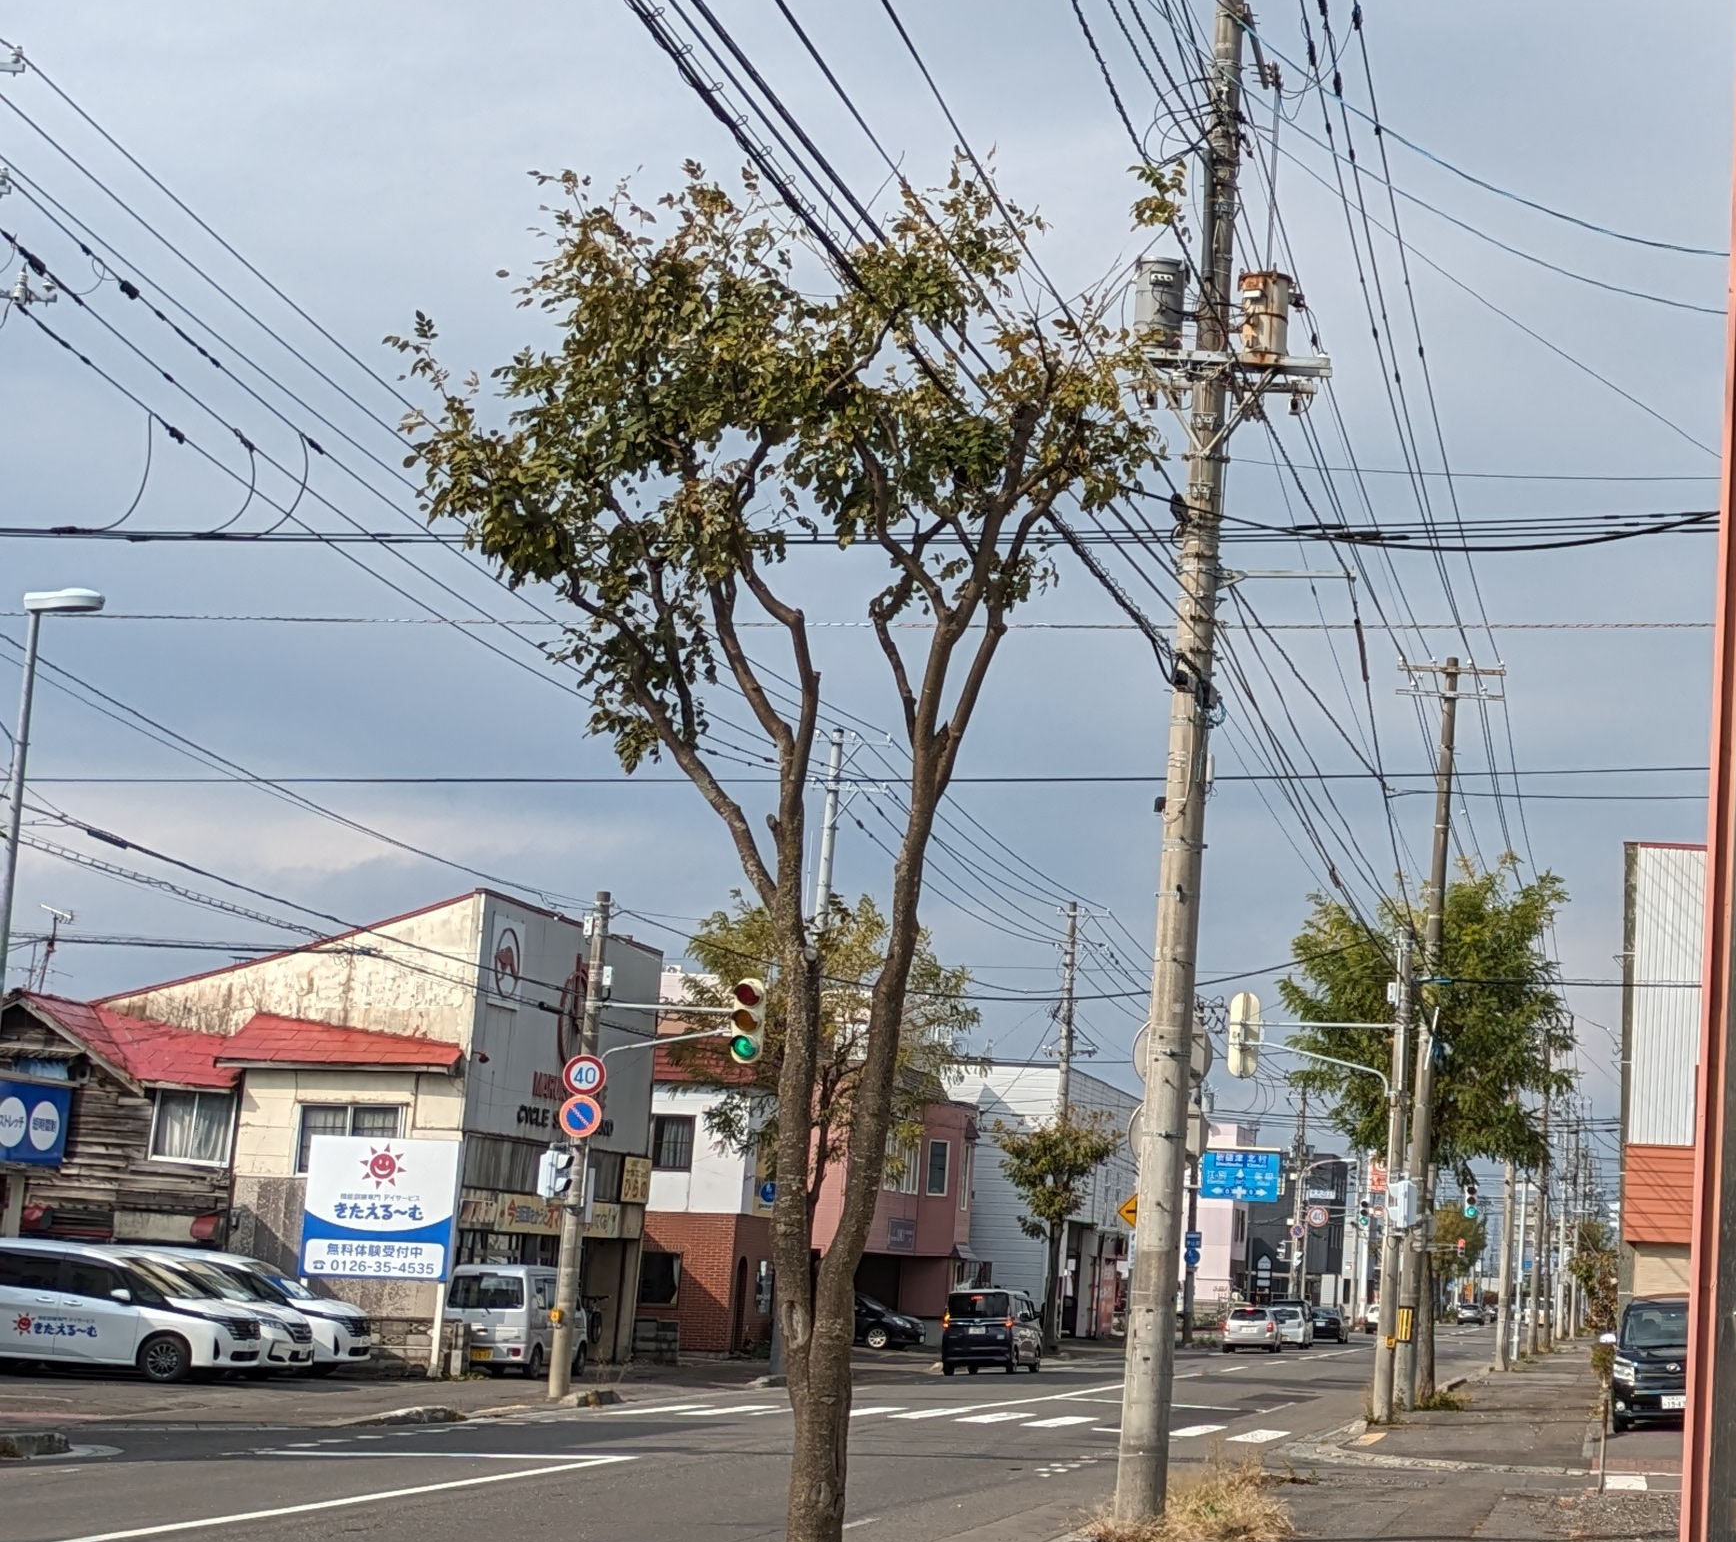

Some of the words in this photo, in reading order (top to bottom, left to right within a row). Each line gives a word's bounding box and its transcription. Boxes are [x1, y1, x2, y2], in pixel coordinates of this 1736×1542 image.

[574, 1067, 597, 1084] 40
[517, 1105, 549, 1128] CYCLE
[326, 1243, 423, 1259] 無料体験受付中
[330, 1259, 434, 1275] 0126-35-4535
